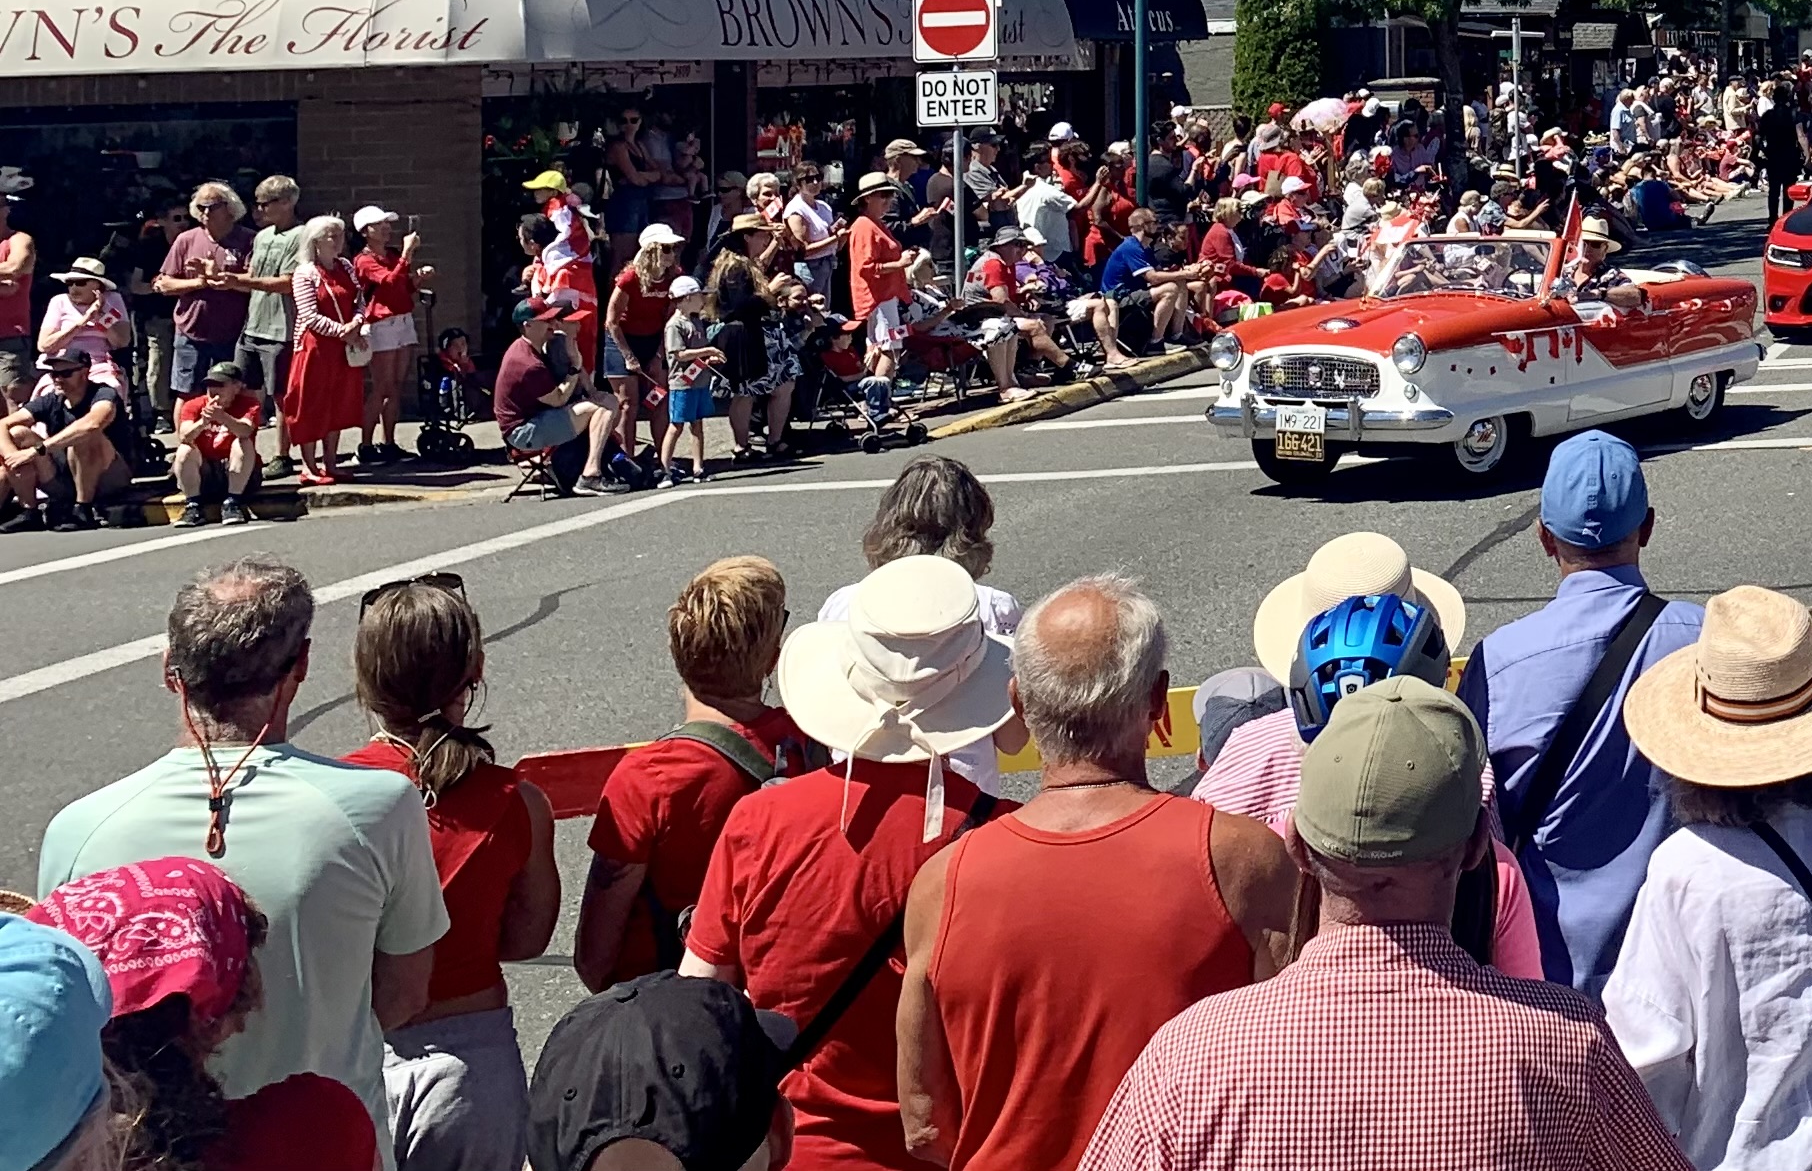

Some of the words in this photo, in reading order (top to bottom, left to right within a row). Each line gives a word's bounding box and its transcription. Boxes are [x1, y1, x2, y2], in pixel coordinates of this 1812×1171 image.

[1116, 0, 1174, 33] Atcus
[922, 80, 947, 98] DO
[953, 78, 991, 96] NOT
[926, 99, 987, 117] ENTER
